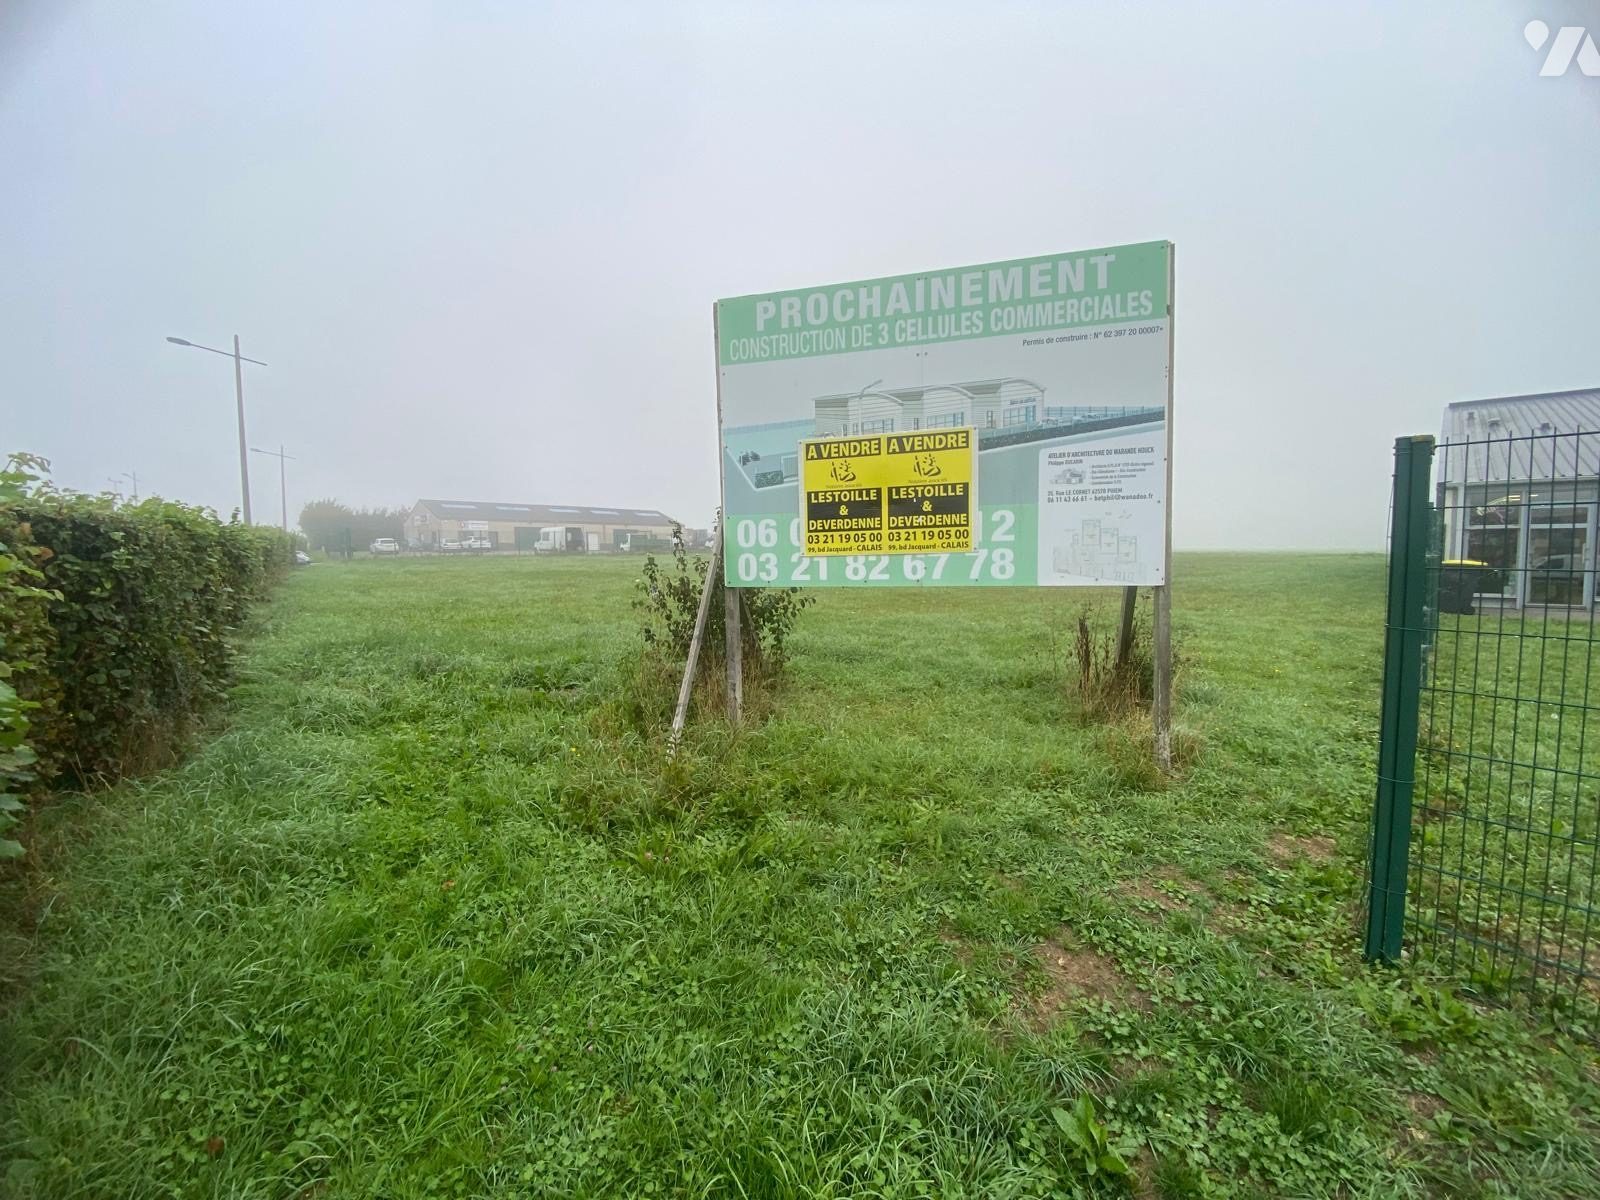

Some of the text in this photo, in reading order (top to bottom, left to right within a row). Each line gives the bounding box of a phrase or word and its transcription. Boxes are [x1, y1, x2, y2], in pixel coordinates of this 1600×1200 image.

[756, 255, 1116, 331] PROCHAINEMENT
[729, 290, 1153, 361] CONSTRUCTION DE 3 CELLULES COMMERCIALES
[1022, 338, 1044, 346] Permis
[1046, 337, 1054, 345] de
[1056, 333, 1088, 343] construire
[1104, 330, 1112, 338] 62
[1114, 329, 1126, 337] 397
[1129, 328, 1137, 336] 20
[807, 440, 880, 460] A VENDRE
[888, 433, 967, 453] A VENDRE
[1048, 451, 1066, 459] ATELIER
[811, 489, 877, 503] LESTOILLE
[892, 484, 964, 499] LESTOILLE
[839, 504, 849, 516] &
[922, 500, 933, 512] &
[808, 517, 880, 531] DEVERDENNE
[889, 513, 967, 528] DEVERDENNE
[737, 518, 778, 548] 06
[807, 532, 882, 544] 03 21 19 05 00
[888, 529, 969, 541] 03 21 19 05 00
[826, 545, 852, 554] Jacquard
[908, 542, 936, 551] Jacquard
[941, 541, 969, 549] CALAIS
[738, 548, 1016, 581] 03 21 82 67 78
